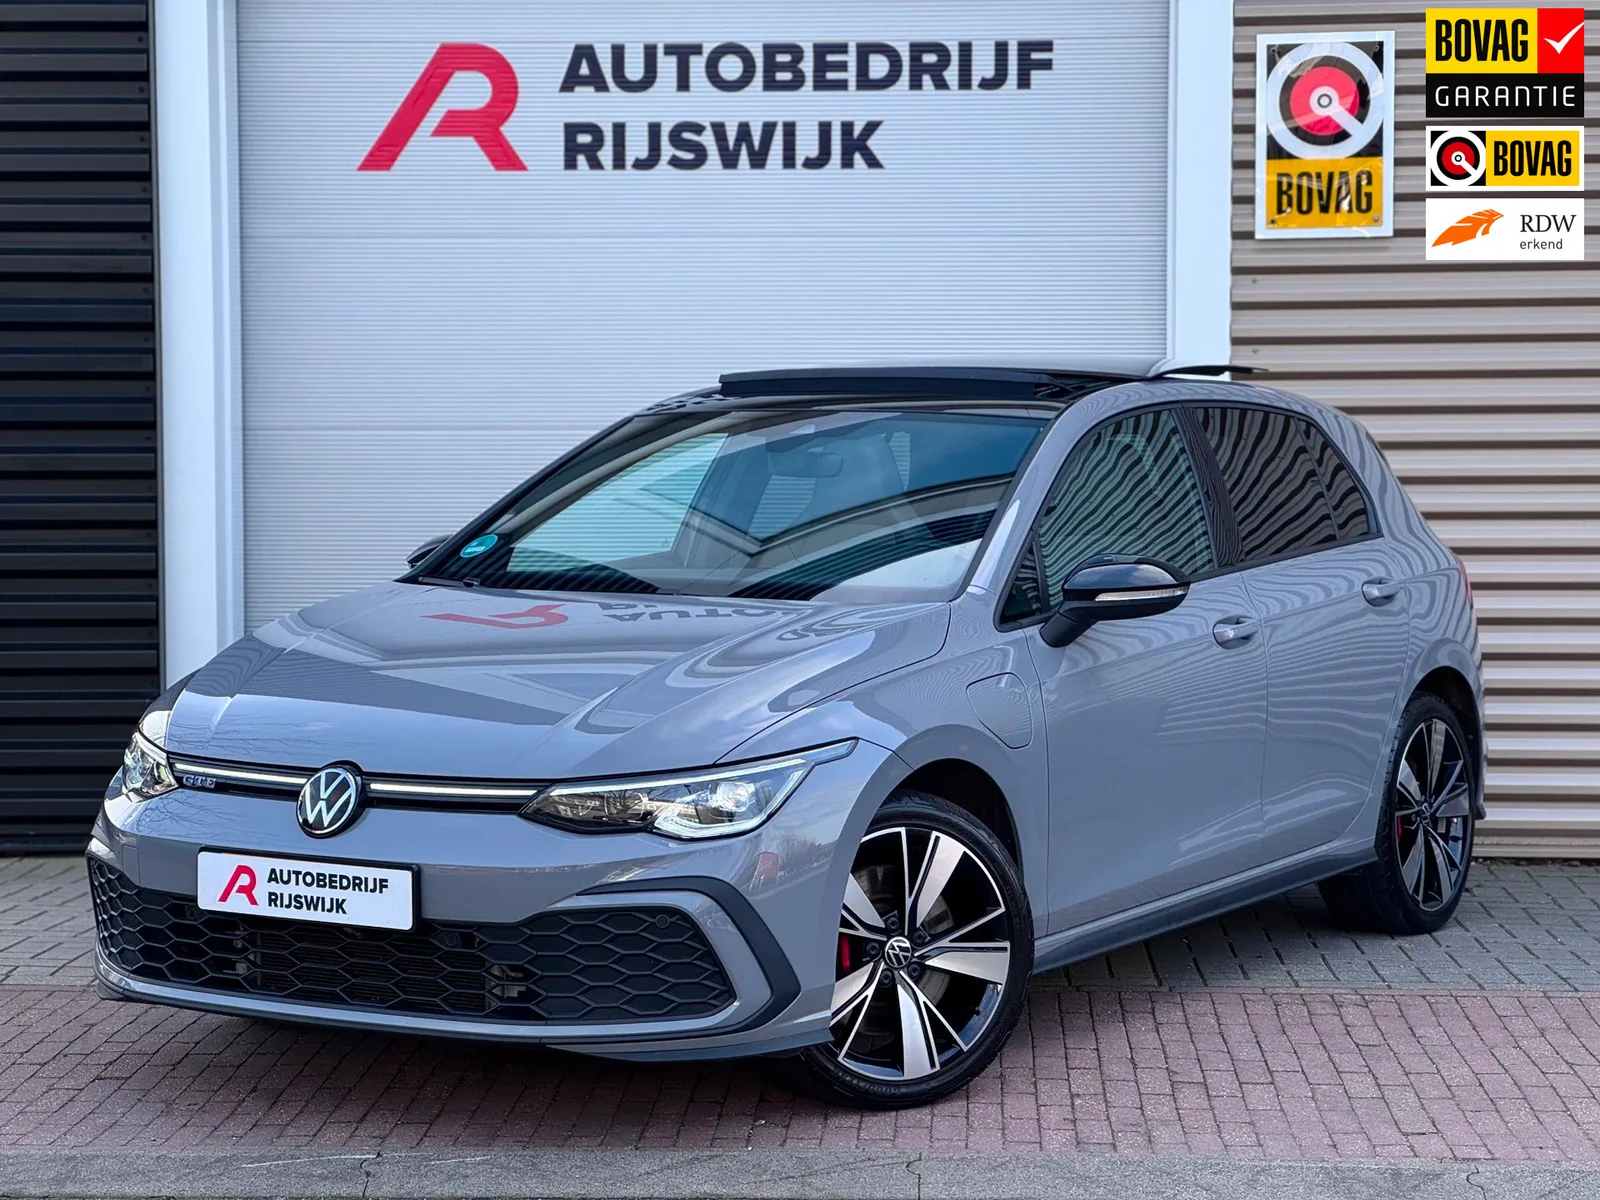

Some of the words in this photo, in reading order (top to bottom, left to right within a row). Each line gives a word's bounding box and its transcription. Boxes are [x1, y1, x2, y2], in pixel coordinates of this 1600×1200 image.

[559, 40, 1054, 93] AUTOBEDRIJF
[563, 120, 884, 171] RIJSWIJK
[1276, 170, 1373, 216] BOVAG
[182, 774, 217, 789] GTE
[267, 867, 389, 894] AUTOBEDRIJF
[268, 891, 347, 915] RIJSWIJK
